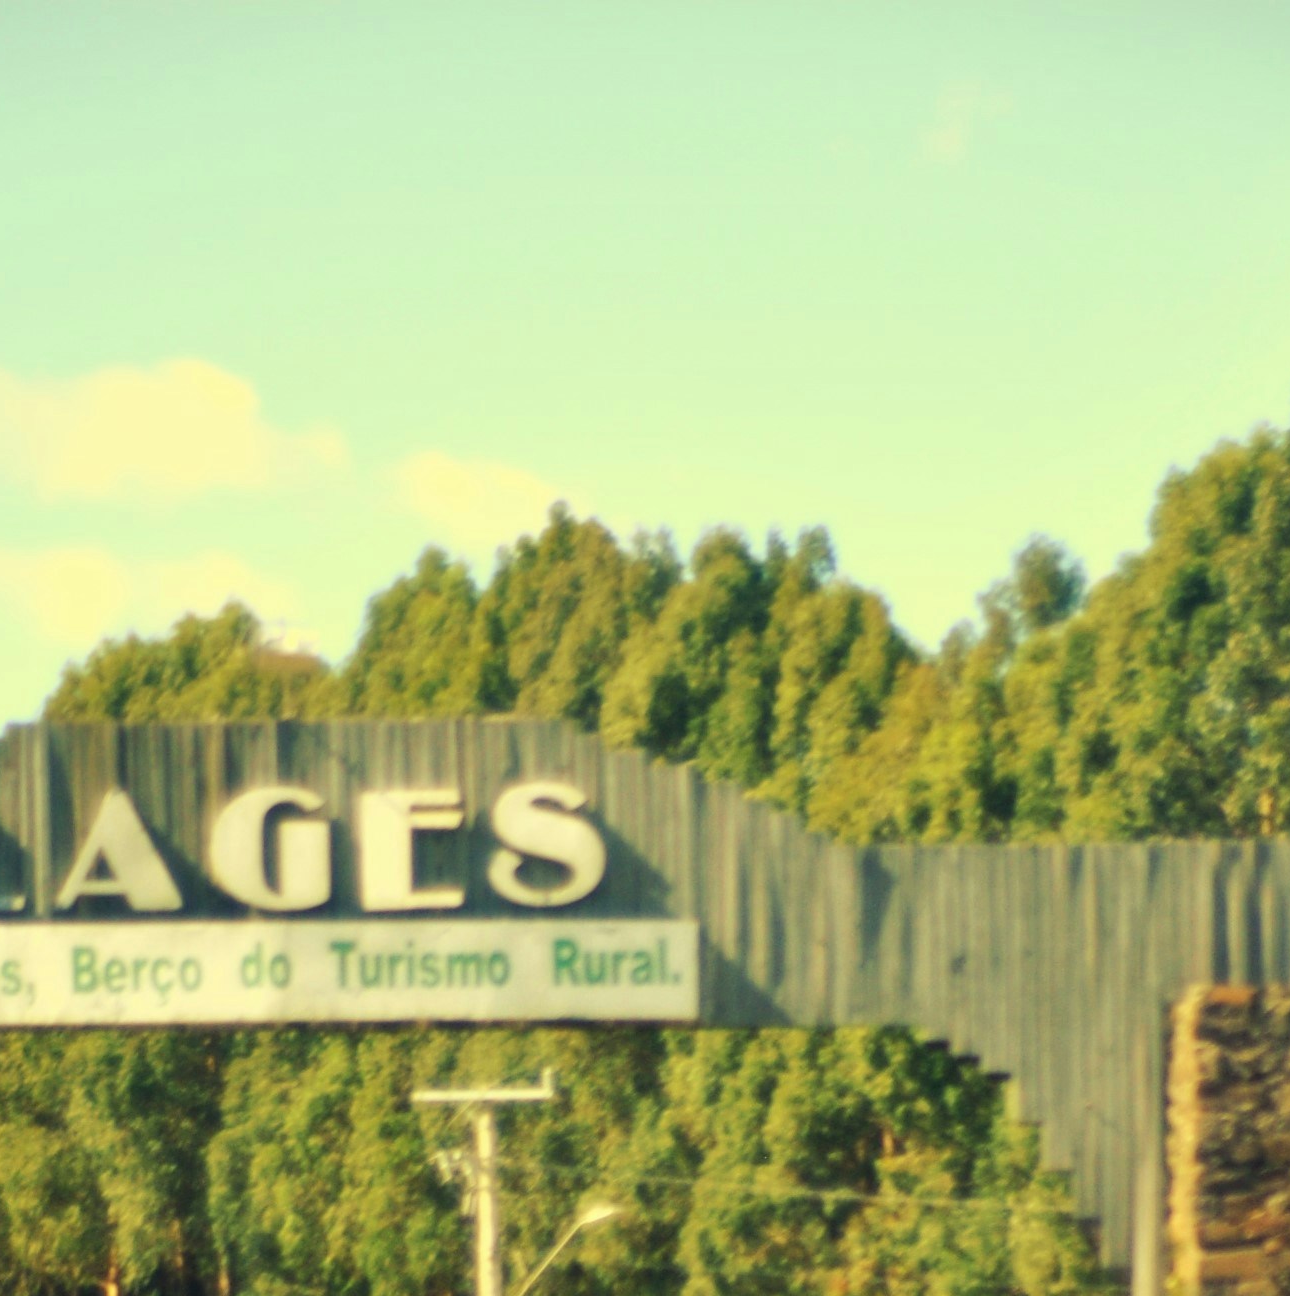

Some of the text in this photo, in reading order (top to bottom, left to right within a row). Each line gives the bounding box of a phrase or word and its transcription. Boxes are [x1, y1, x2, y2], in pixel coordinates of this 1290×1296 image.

[71, 944, 202, 1003] Berço
[240, 941, 292, 989] do
[330, 938, 512, 989] Turismo
[552, 937, 684, 986] Rural.
